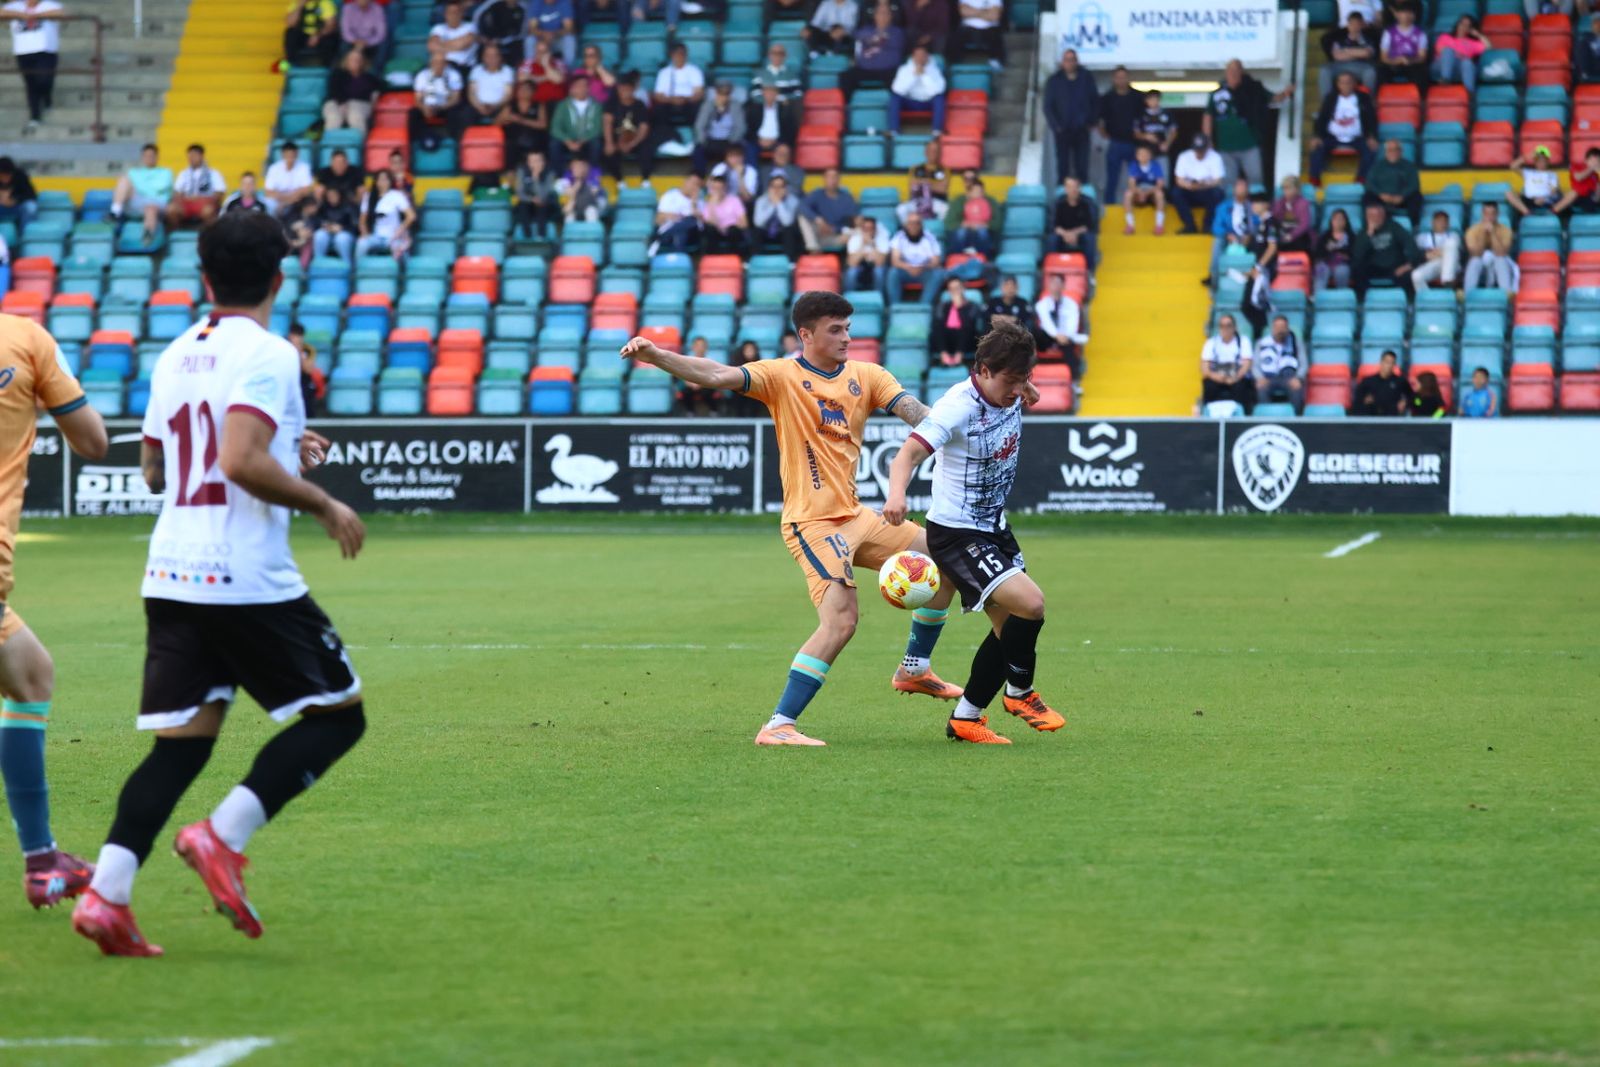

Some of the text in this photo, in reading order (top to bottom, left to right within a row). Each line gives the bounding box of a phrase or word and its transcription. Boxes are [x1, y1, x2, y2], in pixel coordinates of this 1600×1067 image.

[1129, 9, 1271, 27] MINIMARKET
[167, 400, 227, 506] 12
[323, 440, 516, 465] ANTAGLORIA
[628, 445, 750, 470] EL PATO ROJO
[1308, 453, 1441, 473] GOESEGUR
[77, 474, 147, 493] DIS
[1060, 463, 1140, 488] Wake
[76, 501, 103, 515] DE
[105, 501, 161, 515] ALIME
[825, 533, 850, 558] 19
[977, 553, 1004, 578] 15
